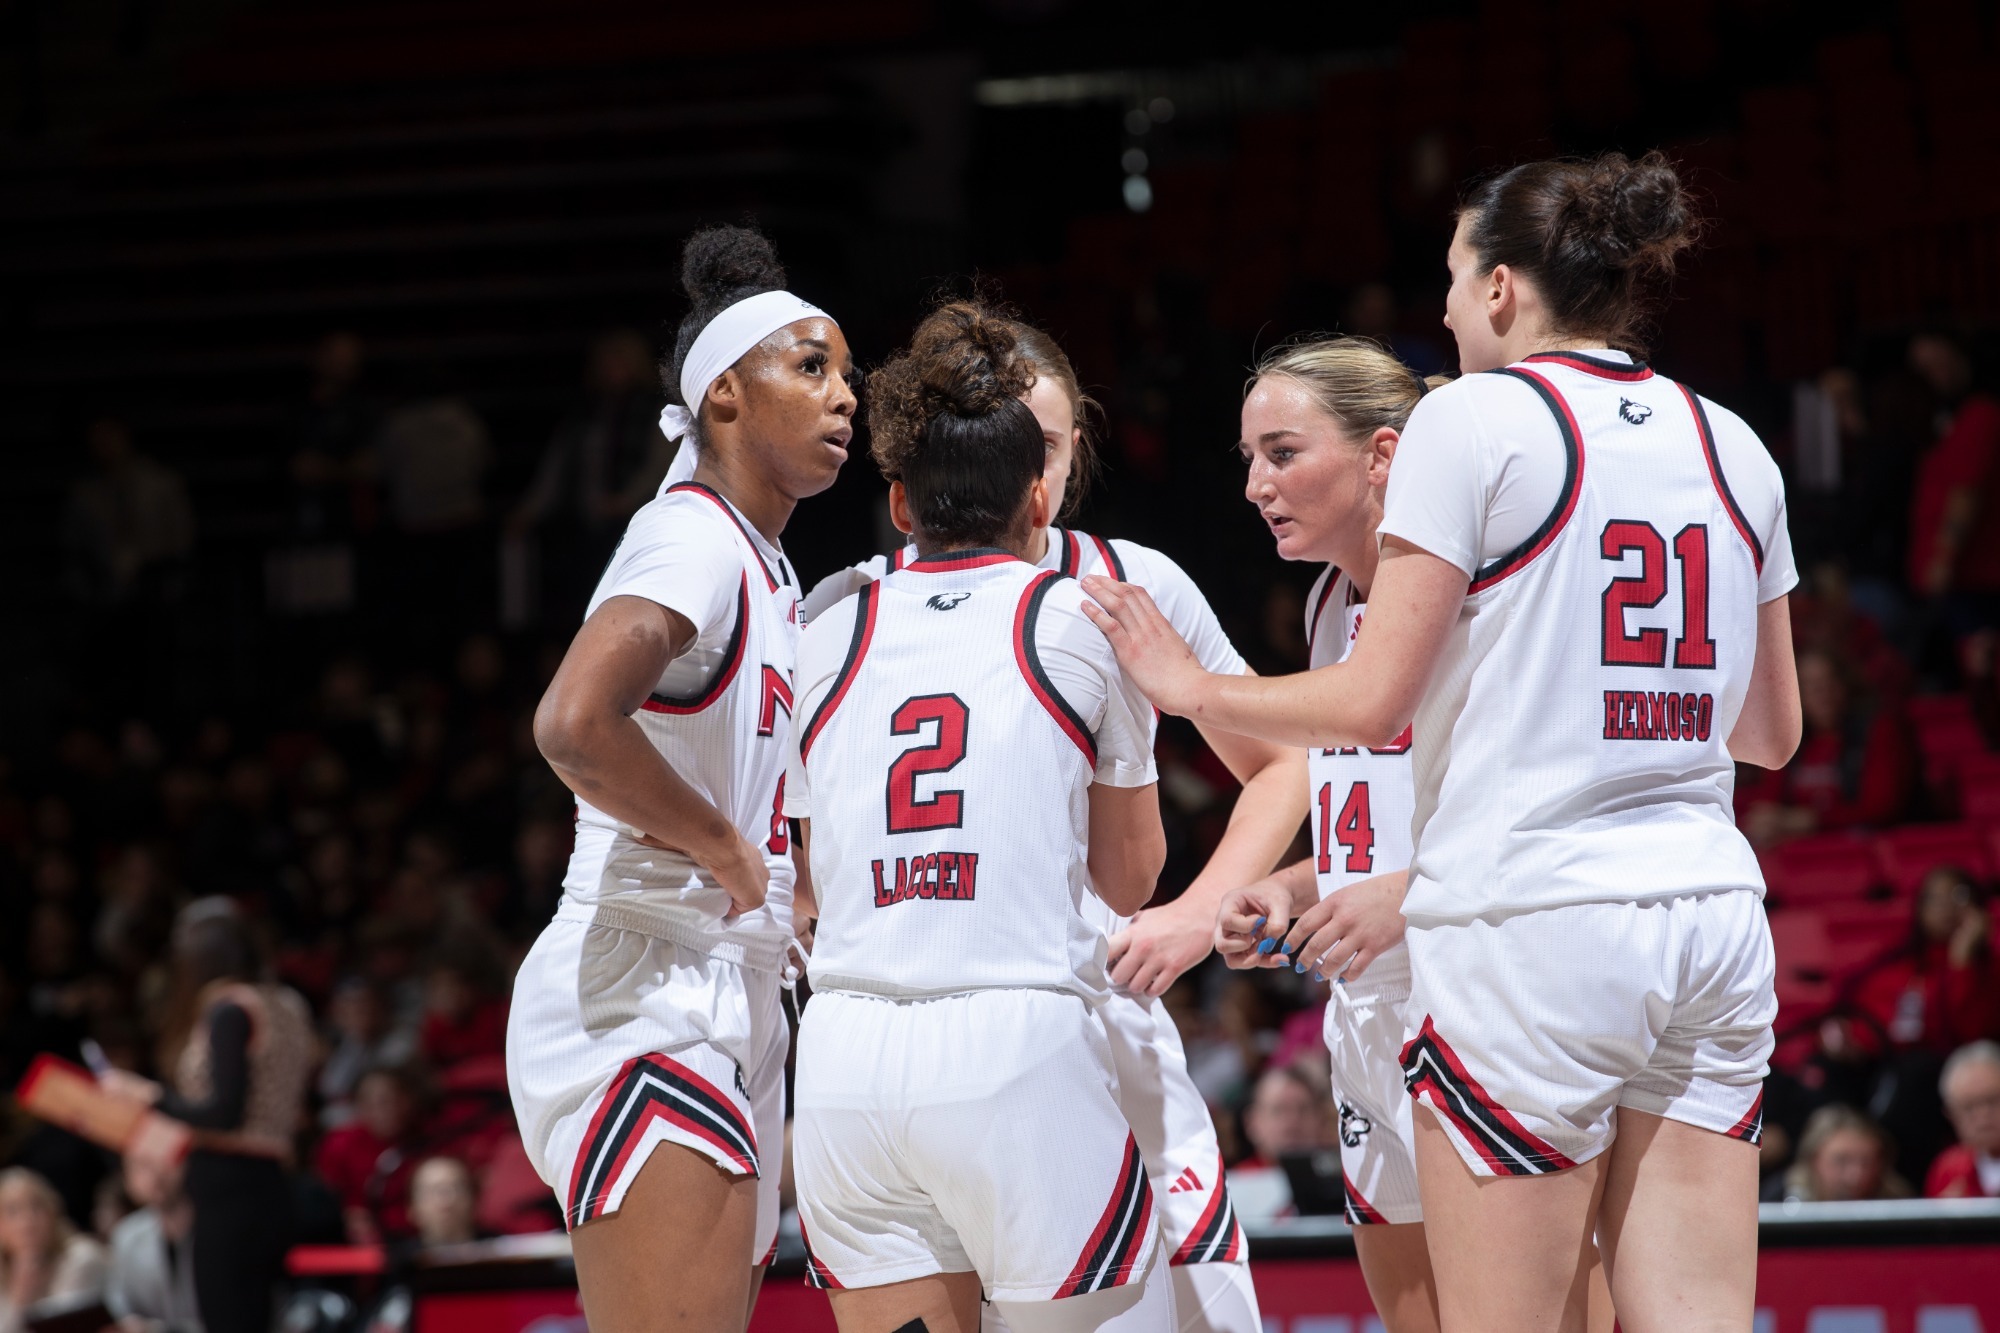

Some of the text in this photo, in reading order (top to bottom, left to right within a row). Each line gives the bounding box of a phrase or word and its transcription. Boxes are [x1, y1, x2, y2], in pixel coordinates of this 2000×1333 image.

[1600, 519, 1716, 669] 21
[1603, 690, 1714, 741] HERMOSO
[886, 692, 970, 835] 2
[1318, 781, 1374, 874] 14
[871, 852, 979, 908] LACCEN
